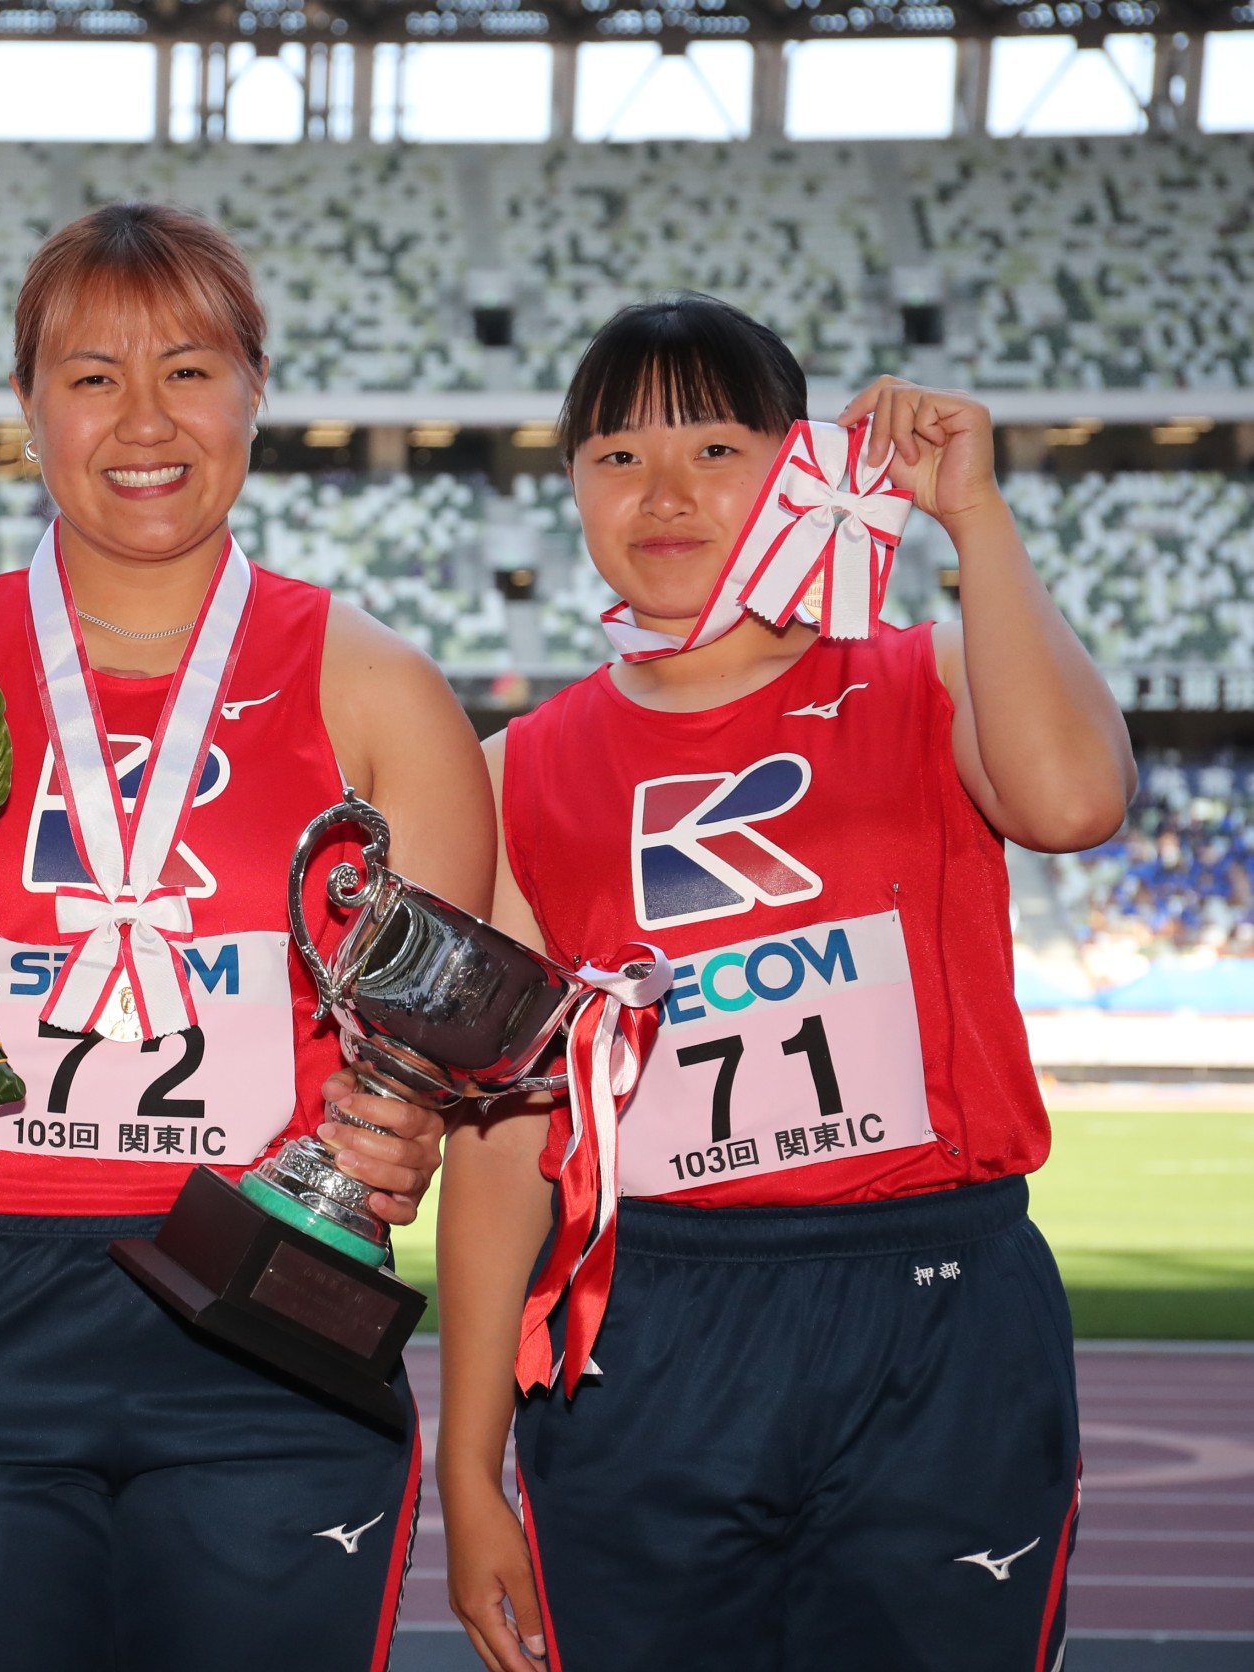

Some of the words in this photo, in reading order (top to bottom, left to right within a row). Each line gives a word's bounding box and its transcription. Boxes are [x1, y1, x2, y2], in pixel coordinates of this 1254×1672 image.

[659, 928, 858, 1027] ECOM
[38, 1019, 205, 1118] 72
[676, 1014, 843, 1143] 71
[13, 1118, 99, 1150] 103回
[118, 1124, 226, 1156] 関東IC
[669, 1138, 760, 1180] 103回
[774, 1113, 885, 1161] 関東IC
[914, 1261, 961, 1286] 押部
